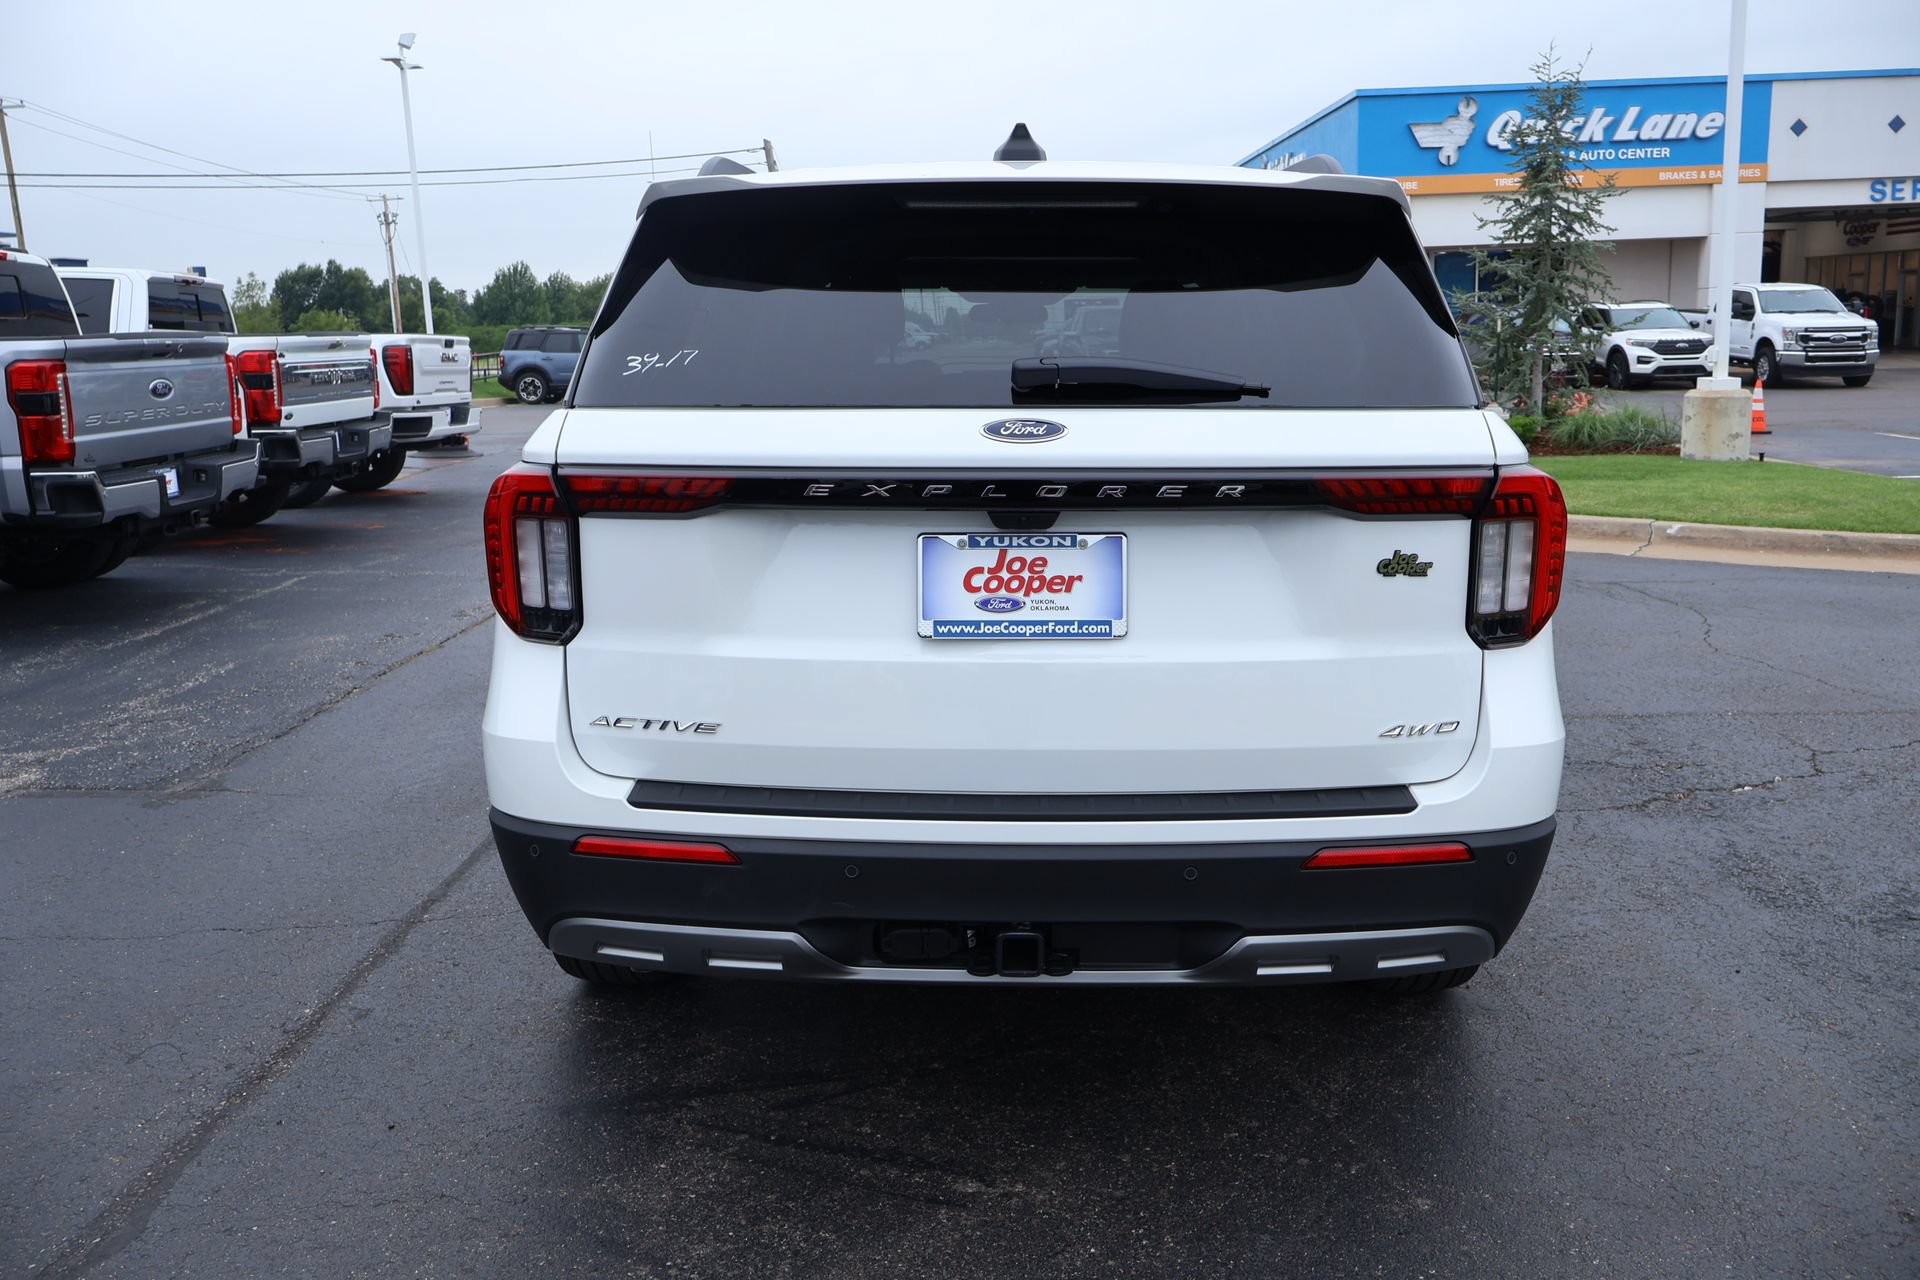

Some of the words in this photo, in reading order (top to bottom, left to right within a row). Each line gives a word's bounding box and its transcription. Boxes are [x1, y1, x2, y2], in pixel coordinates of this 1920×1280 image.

[1613, 106, 1725, 142] Lane
[1579, 149, 1616, 161] AUTO
[1618, 147, 1671, 160] CENTER
[1659, 170, 1698, 180] BRAKES
[1708, 168, 1761, 178] BARIES
[85, 407, 171, 427] SUPER
[175, 401, 226, 416] DUTY
[1000, 420, 1048, 435] Ford
[803, 484, 1246, 497] EXPLORER
[975, 536, 1073, 547] YUKON
[987, 548, 1048, 575] Joe
[1391, 550, 1419, 565] Joe
[1377, 559, 1434, 575] Cooper
[963, 566, 1083, 597] Cooper
[987, 598, 1014, 610] Ford
[936, 621, 1110, 637] www.JoeCooperFord.com
[589, 715, 723, 734] ACTIVE
[1378, 720, 1460, 738] 4WD
